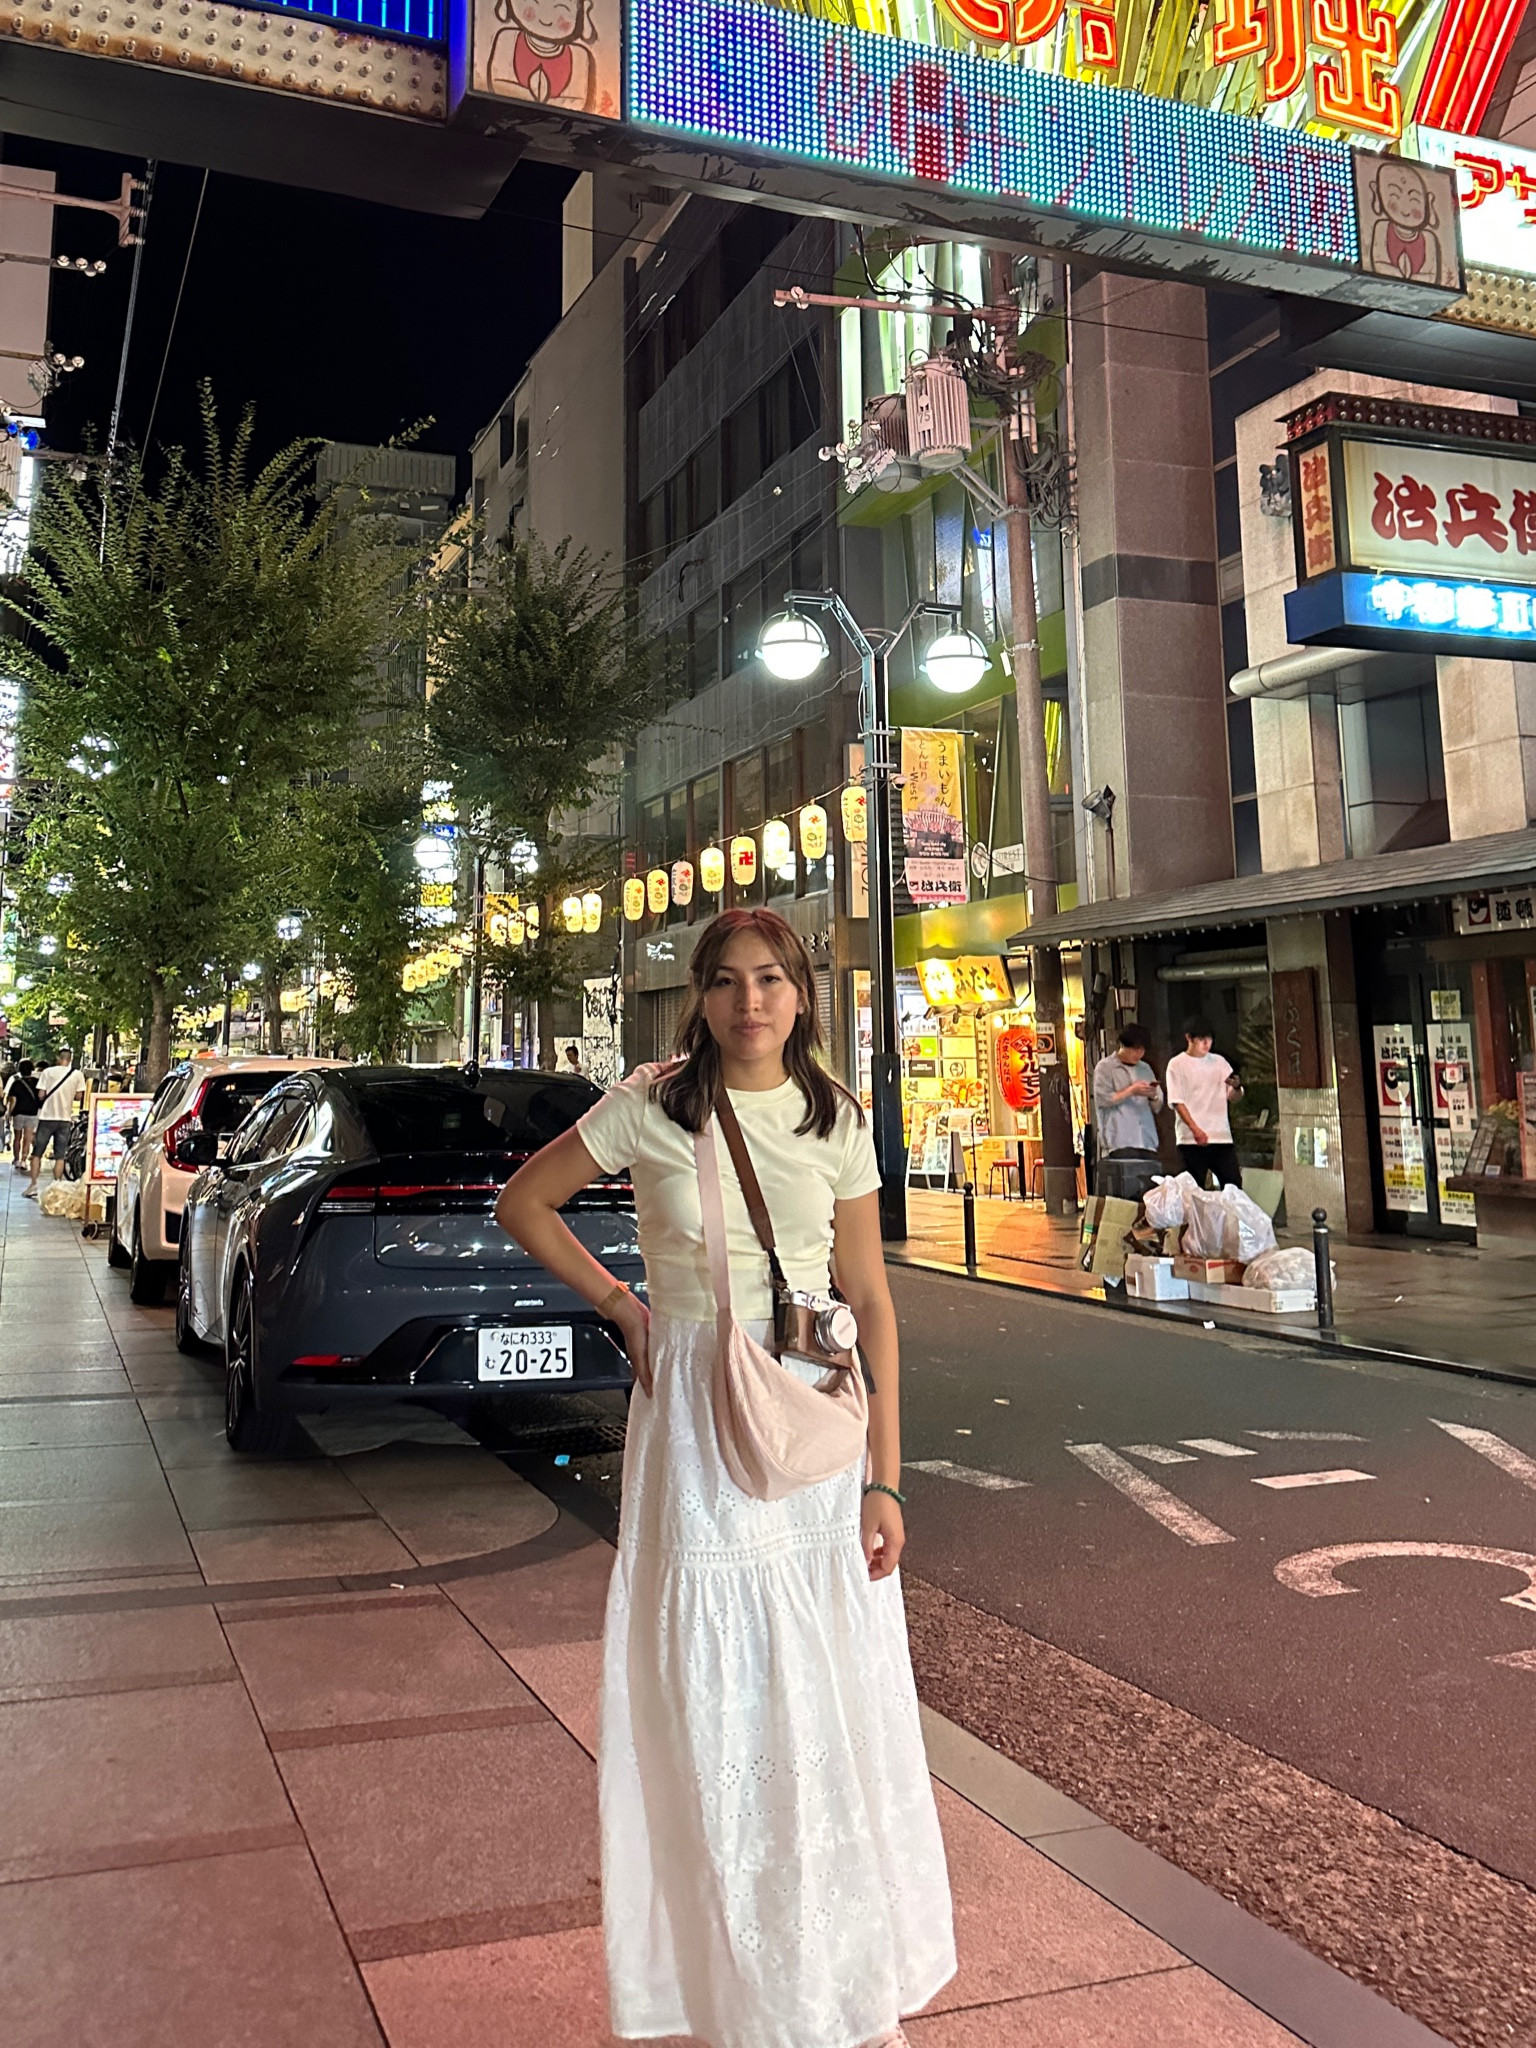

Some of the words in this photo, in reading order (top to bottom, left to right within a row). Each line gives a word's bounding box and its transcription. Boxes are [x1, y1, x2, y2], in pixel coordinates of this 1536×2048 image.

[500, 1331, 530, 1346] なにわ
[530, 1331, 552, 1345] 333
[485, 1355, 496, 1370] む
[500, 1347, 567, 1375] 20-25
